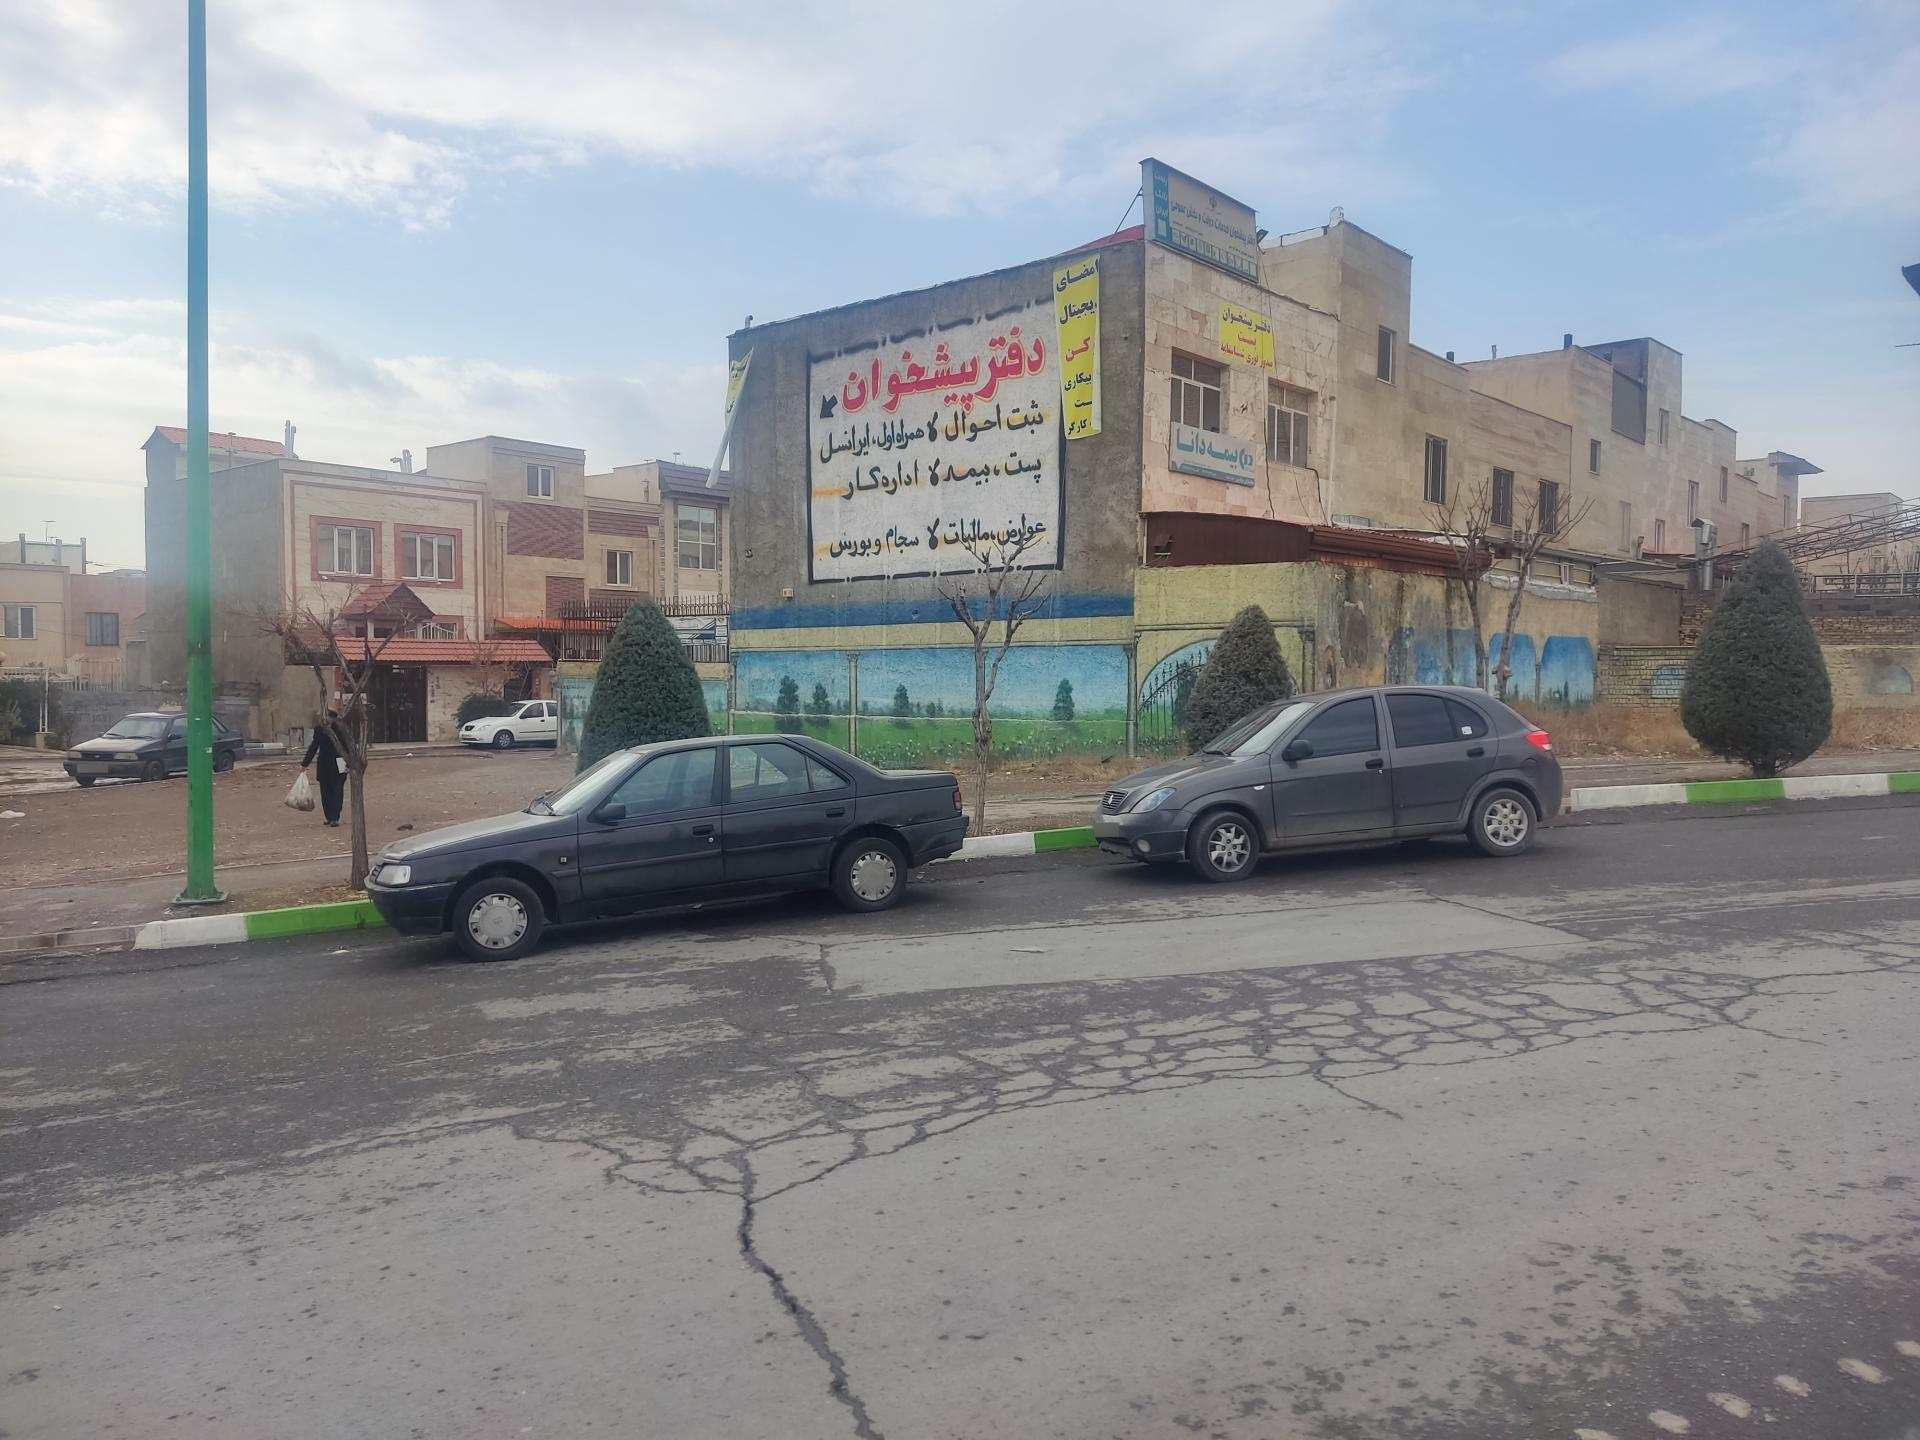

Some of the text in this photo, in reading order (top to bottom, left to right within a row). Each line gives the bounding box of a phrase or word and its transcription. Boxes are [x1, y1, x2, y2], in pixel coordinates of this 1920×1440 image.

[1056, 258, 1098, 292] امضای
[1254, 320, 1271, 333] دفتر
[842, 325, 1046, 414] دفتر پیشخوان
[896, 418, 924, 449] همراه
[945, 403, 1001, 442] احوال
[1007, 400, 1044, 434] ثبت
[820, 422, 870, 463] ایرانسل
[1176, 428, 1238, 469] بیمه دانا
[841, 465, 881, 500] کار
[881, 458, 919, 495] اداره
[944, 463, 991, 486] بیمه
[885, 524, 919, 553] سجام
[943, 517, 990, 545] مالیات
